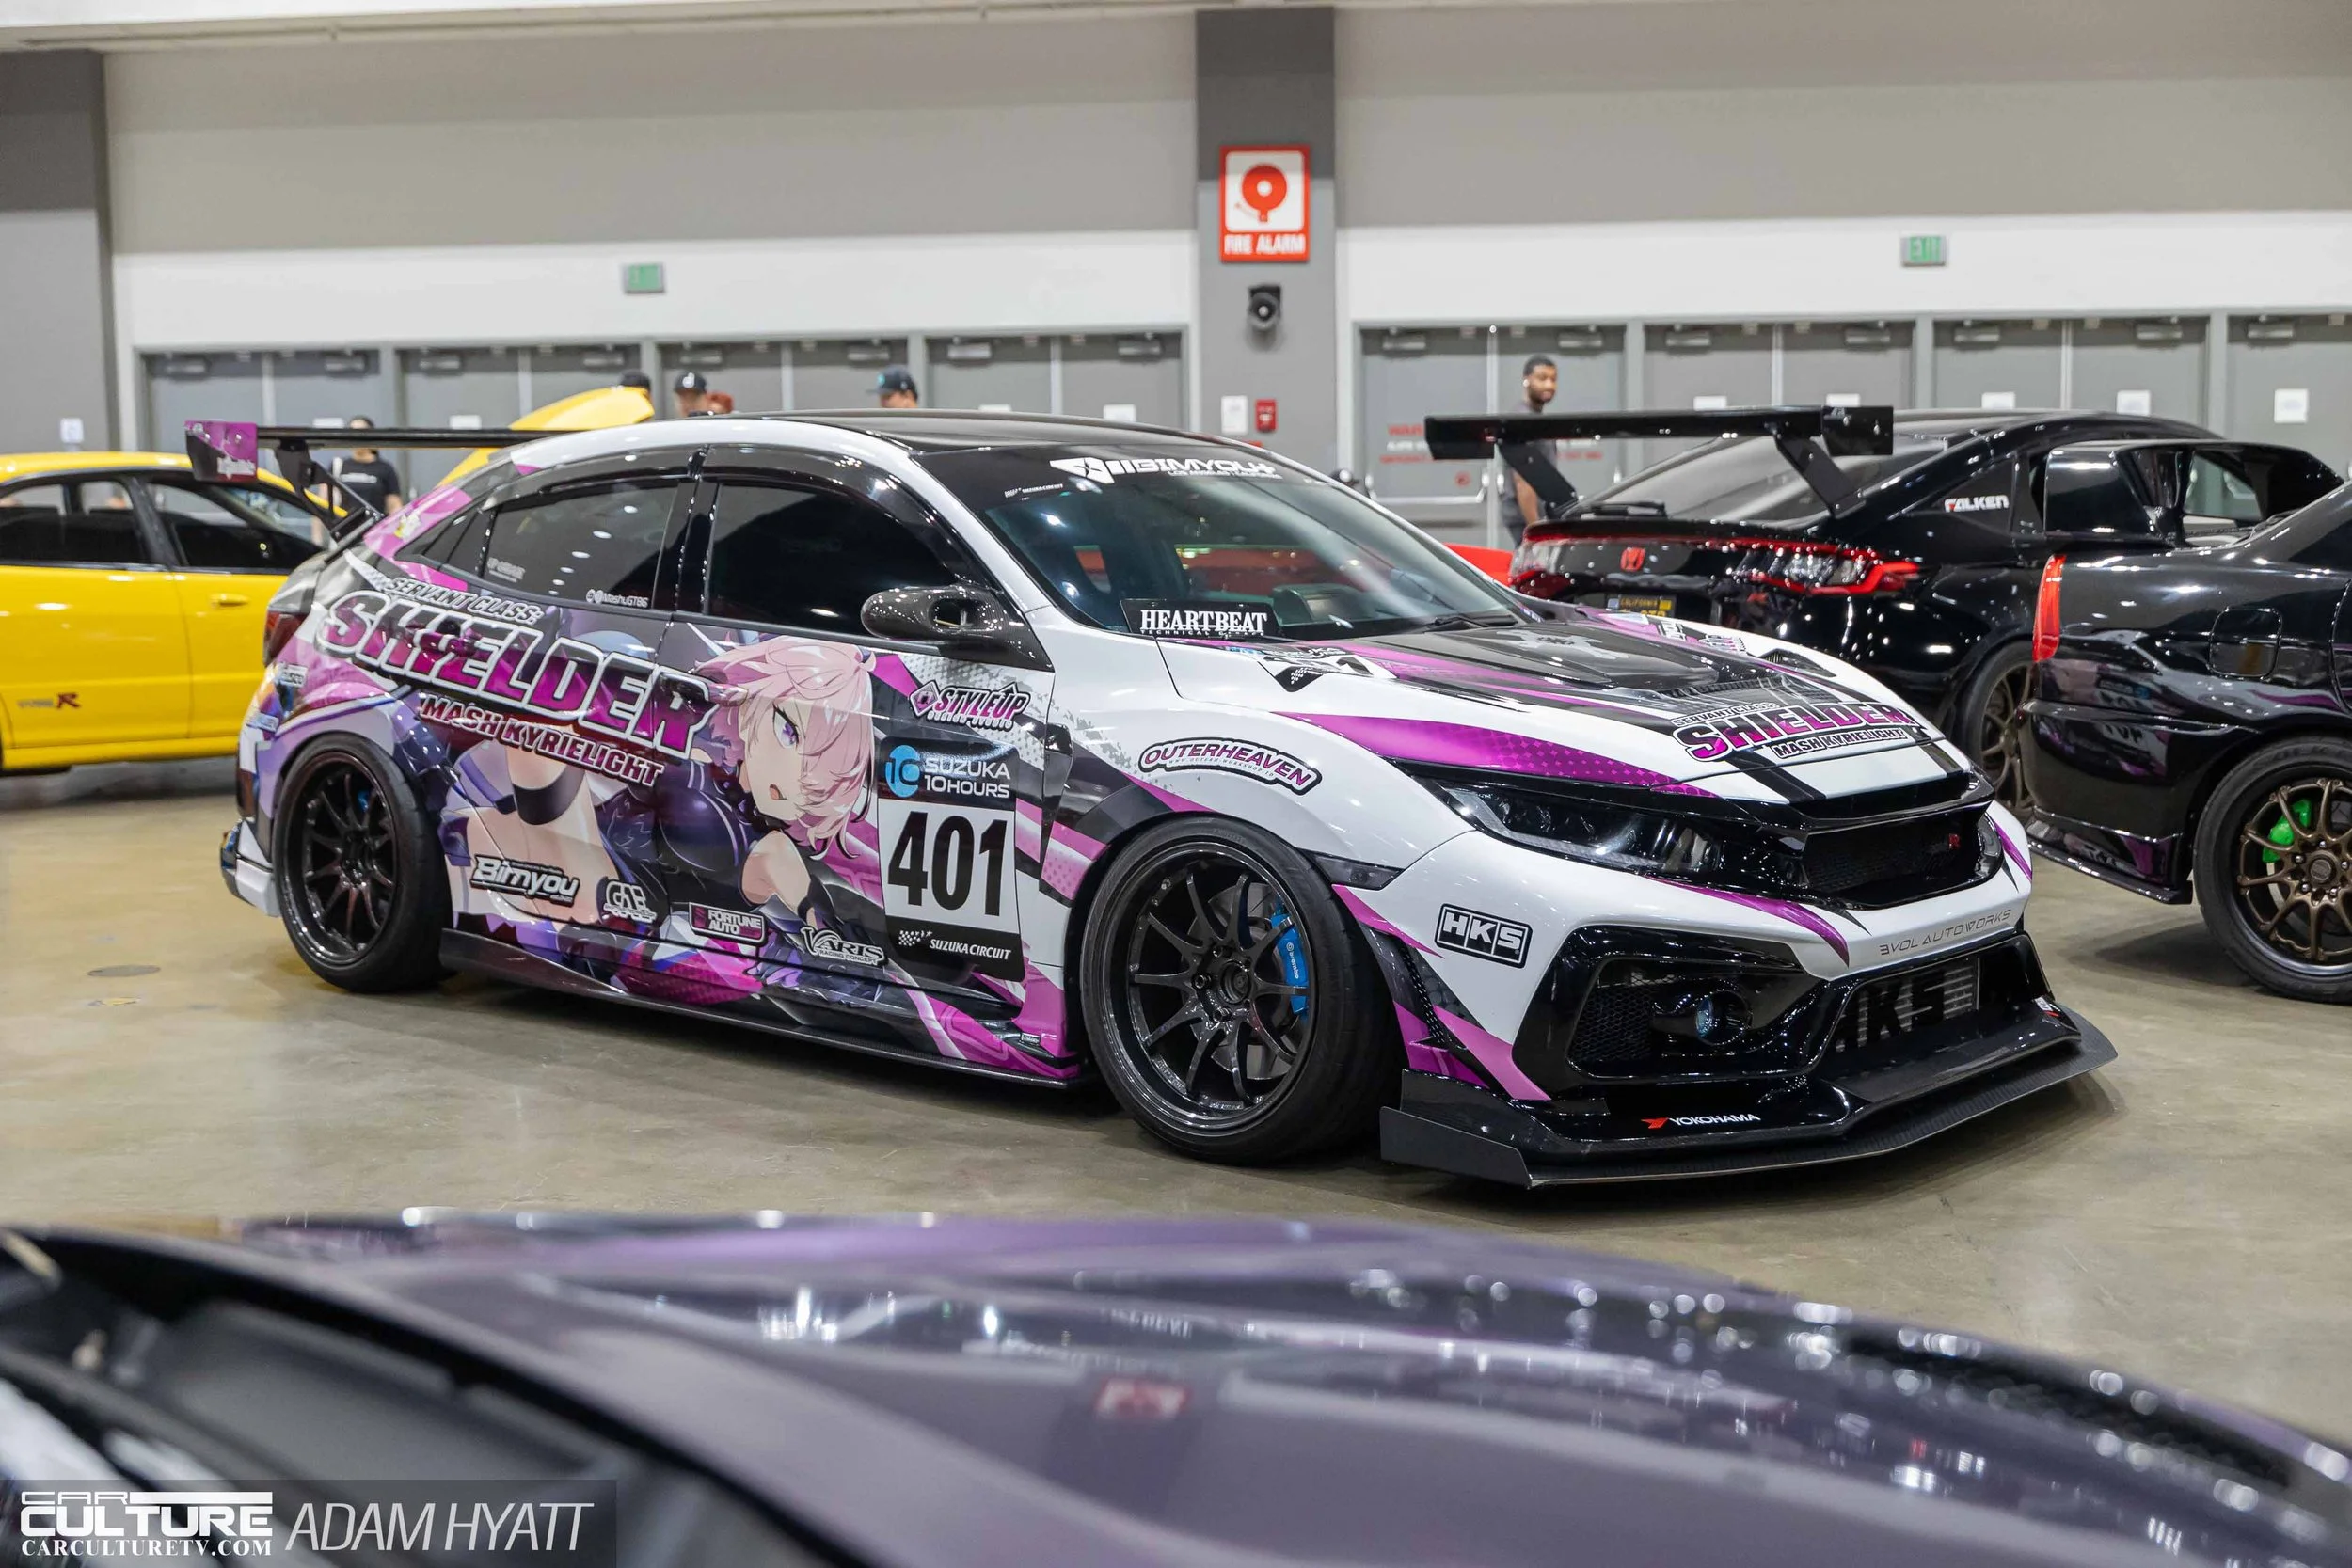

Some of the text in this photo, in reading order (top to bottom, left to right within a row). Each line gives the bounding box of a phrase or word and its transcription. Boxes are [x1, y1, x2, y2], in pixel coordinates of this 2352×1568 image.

[1224, 234, 1306, 255] FIRE ALARM
[1944, 494, 2010, 513] FALKEN
[389, 577, 478, 610] SERVANT
[1139, 609, 1268, 633] HEARTBEAT
[315, 589, 721, 759] SHIELDER
[1671, 706, 1730, 727] SERVANT
[418, 692, 666, 787] MASH KYRIELIGHT
[1673, 702, 1915, 763] SHIELDER
[1769, 727, 1908, 759] MASH KYRIELIGHT
[924, 755, 1011, 781] SUZUKA
[1144, 743, 1313, 786] OUTERHEAVEN
[924, 774, 1010, 799] 10HOURS
[472, 856, 580, 897] Bimyou
[887, 811, 1008, 917] 401
[707, 909, 762, 928] FORTUNE
[708, 921, 740, 936] AUTO
[1442, 911, 1524, 951] HKS
[1921, 909, 2012, 945] AUTOWORKS
[801, 926, 886, 959] VARIS
[819, 949, 879, 965] RACING CONCEPT
[1289, 951, 1300, 979] brembo
[1668, 1113, 1762, 1126] YOKOHAMA
